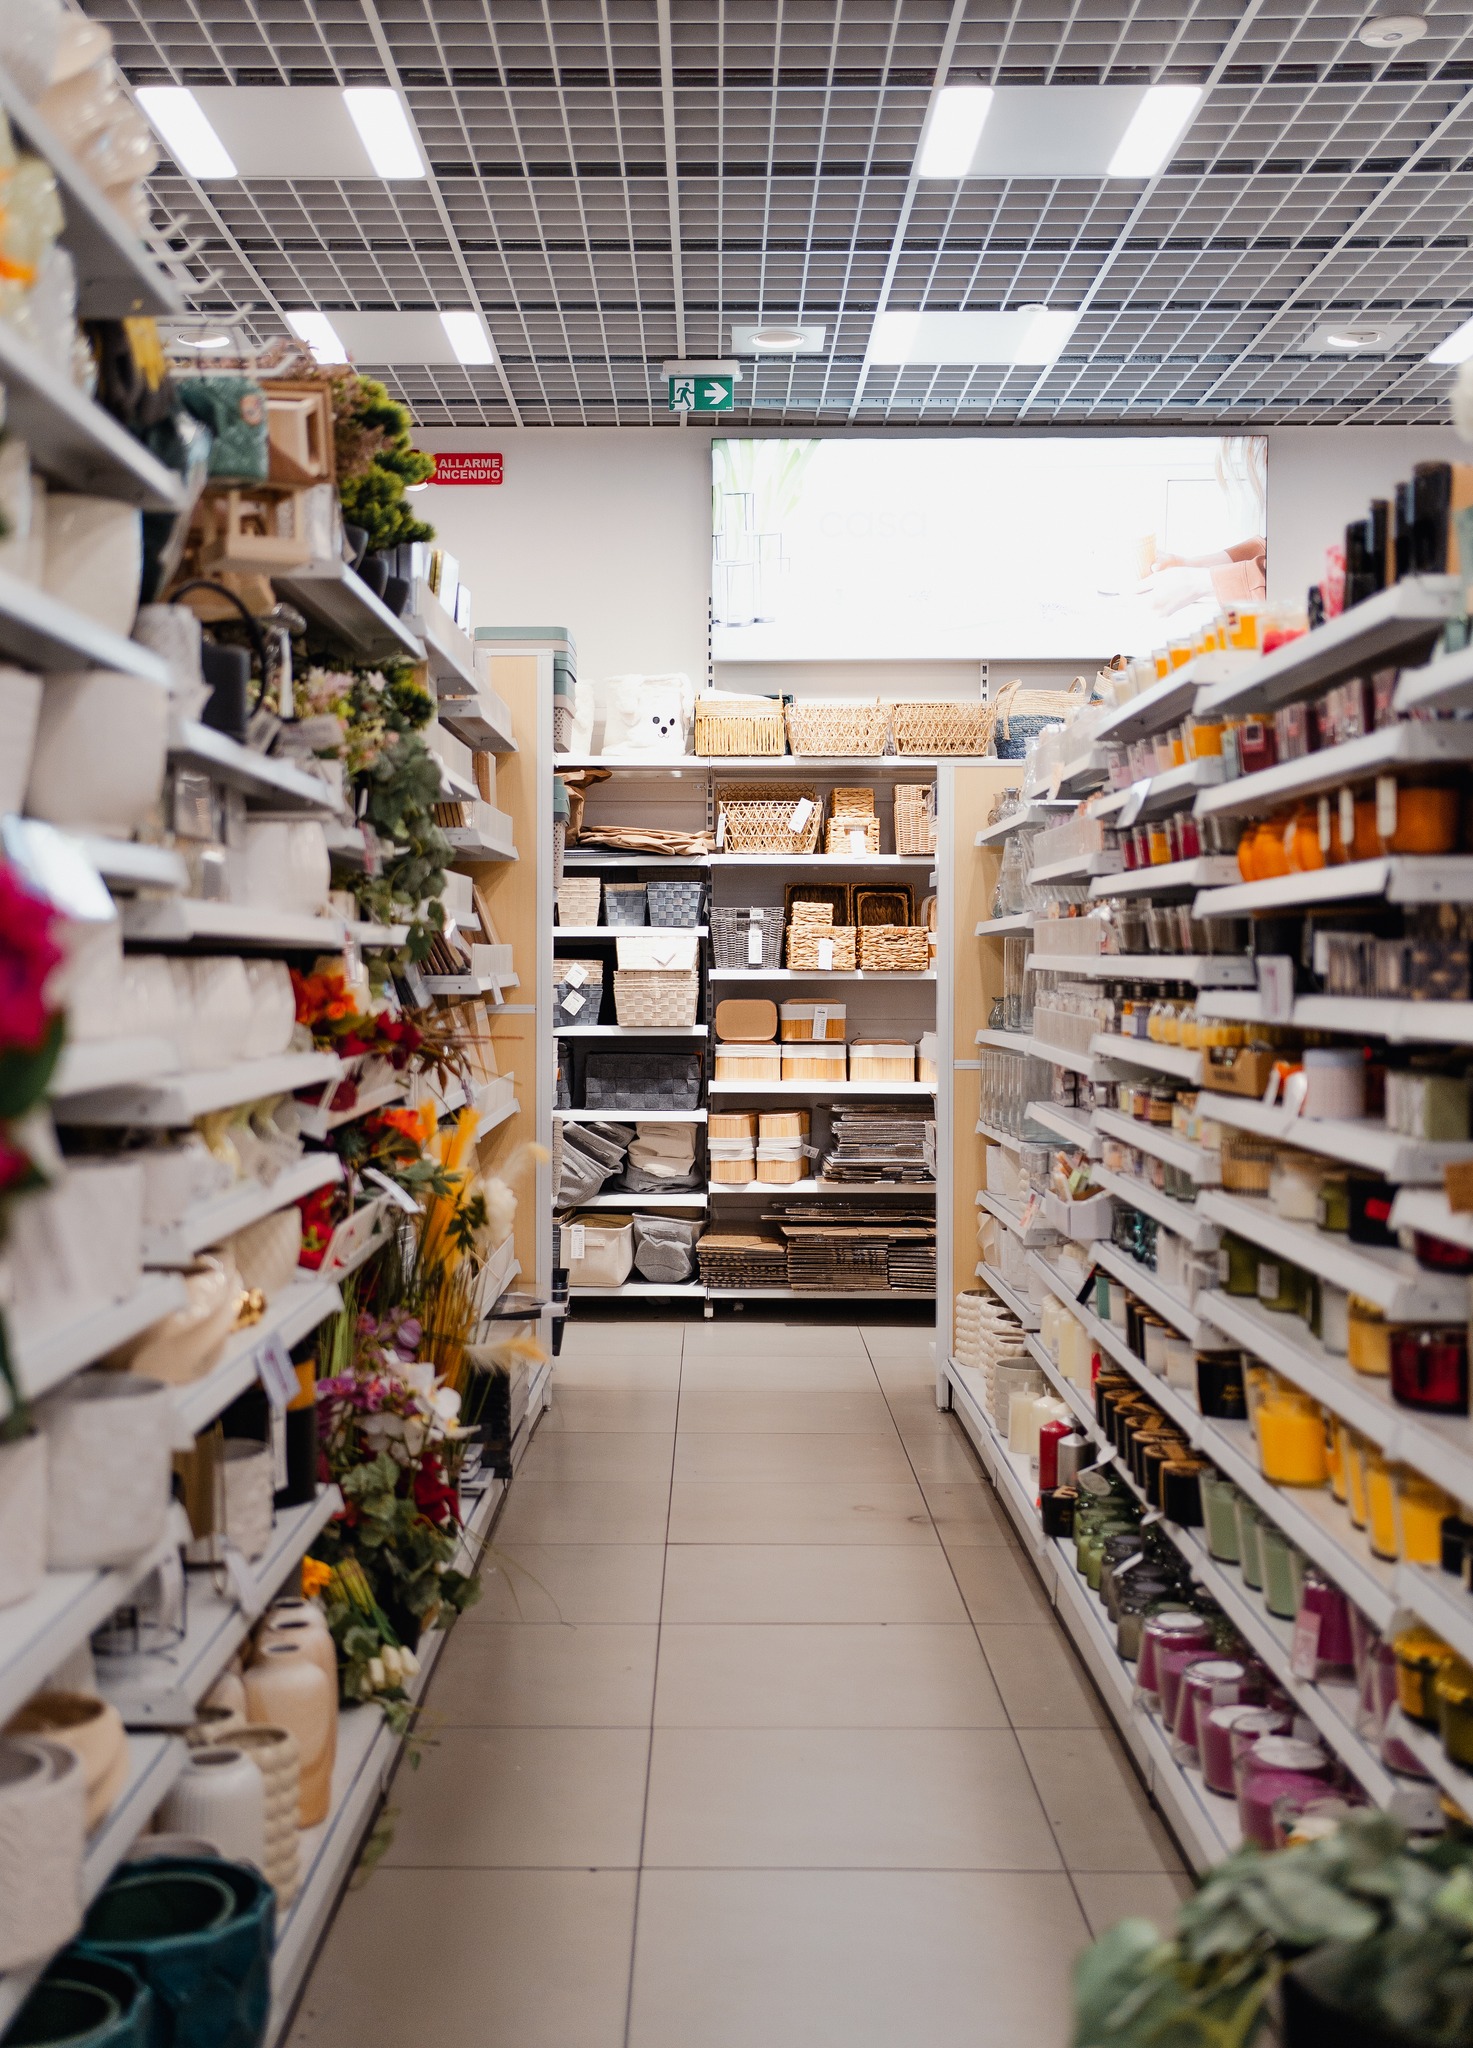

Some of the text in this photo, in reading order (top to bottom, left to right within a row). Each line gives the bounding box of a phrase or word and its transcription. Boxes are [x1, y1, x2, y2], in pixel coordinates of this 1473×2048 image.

[439, 459, 500, 468] ALLARME
[437, 470, 500, 479] INCENDIO
[820, 511, 927, 538] casa
